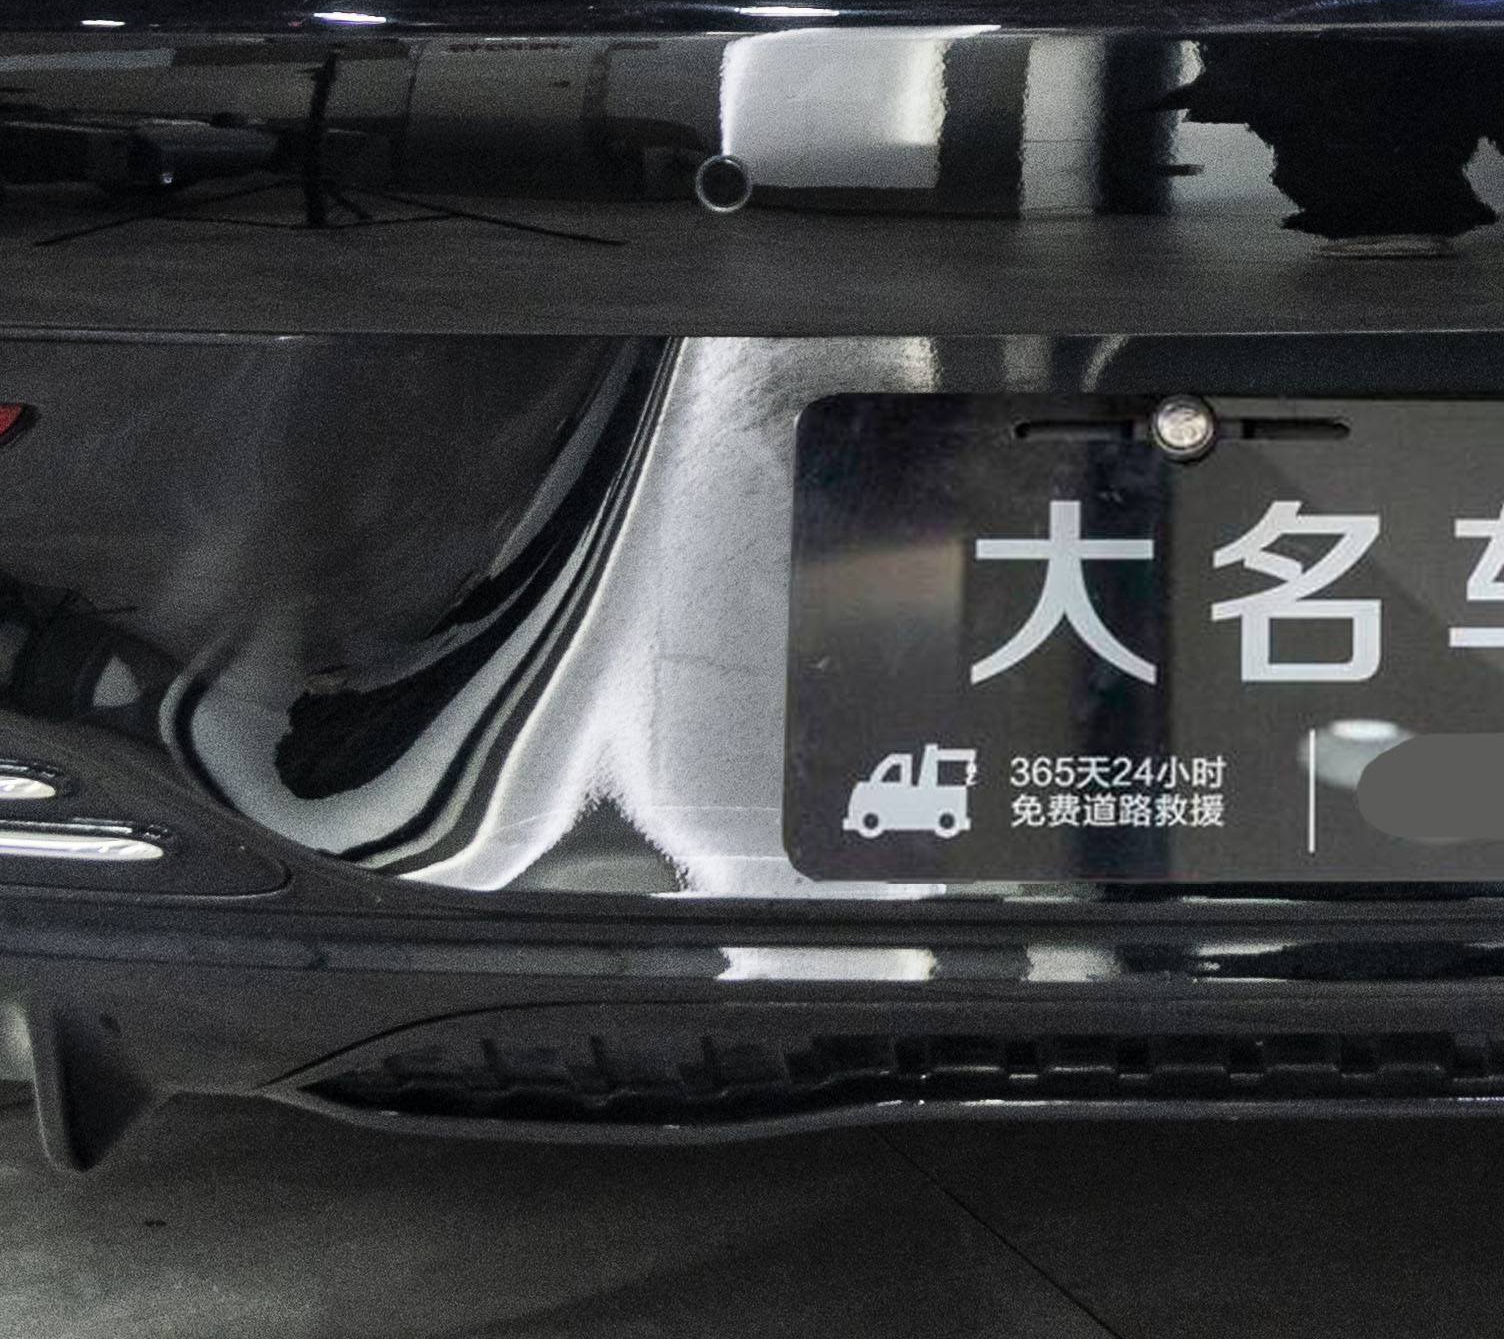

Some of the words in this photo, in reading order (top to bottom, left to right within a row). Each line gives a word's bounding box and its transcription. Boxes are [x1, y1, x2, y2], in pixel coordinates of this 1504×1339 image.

[1009, 756, 1227, 789] 365天24小时
[1010, 793, 1225, 828] 免费道路救援
